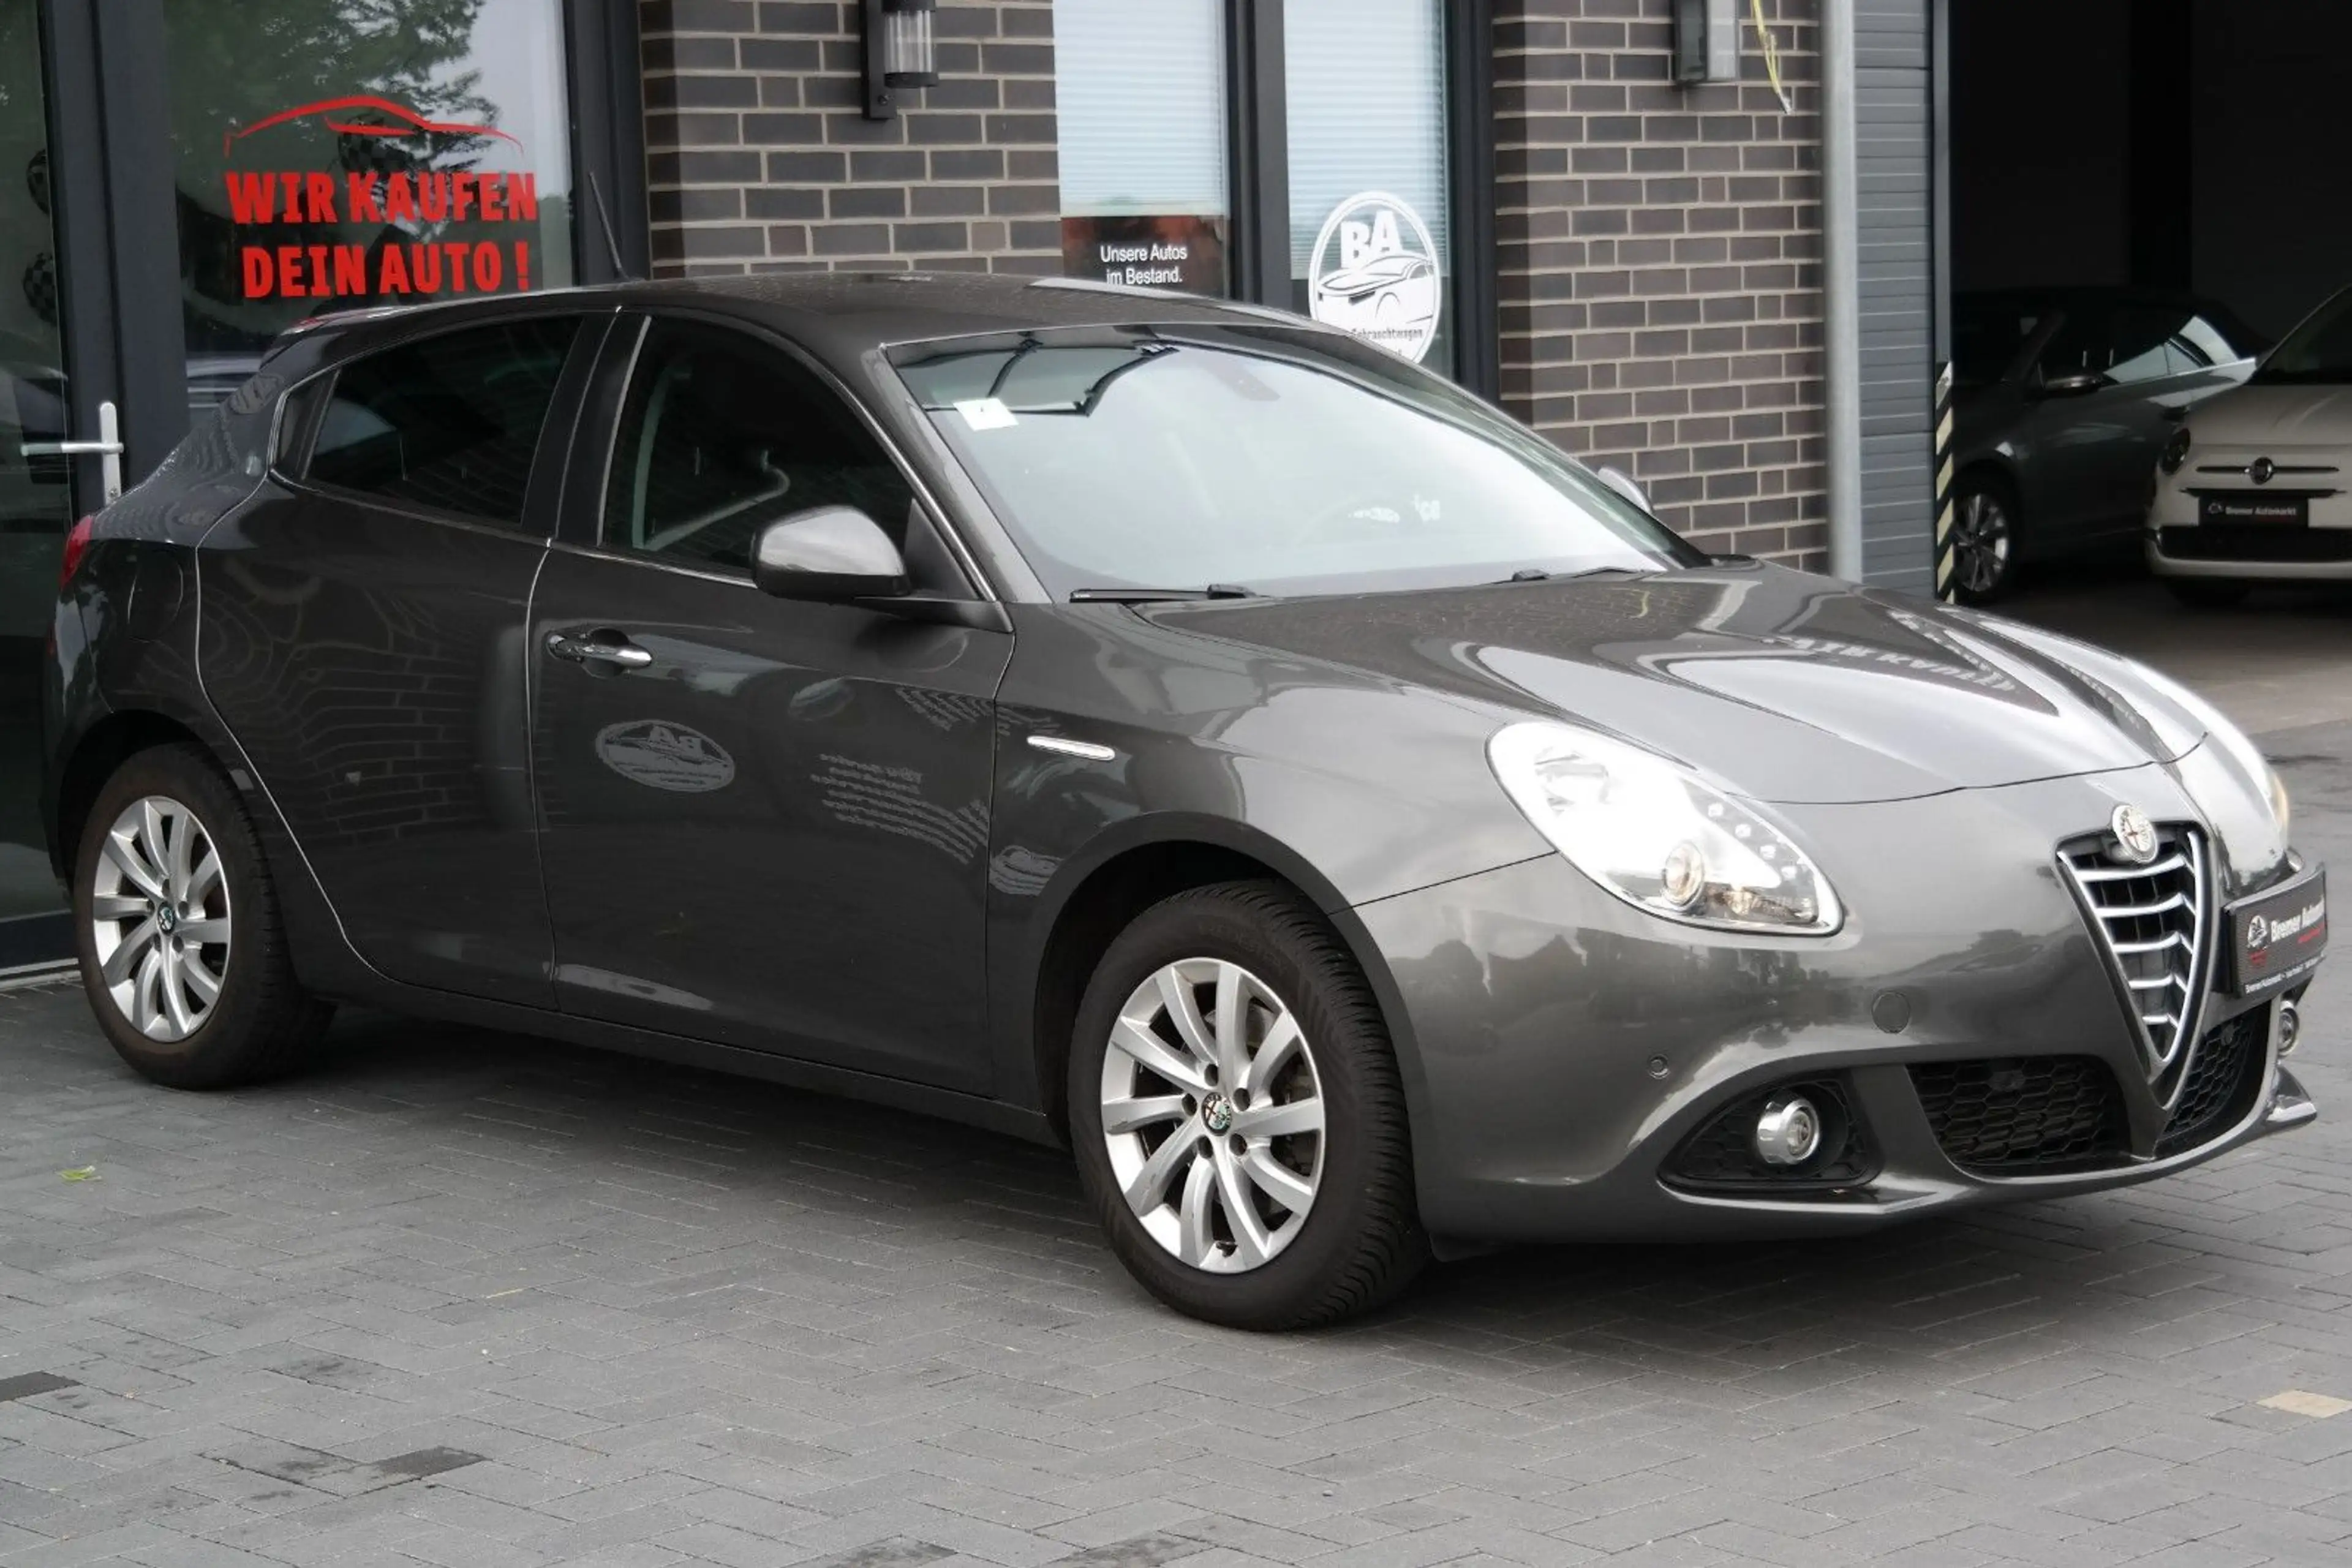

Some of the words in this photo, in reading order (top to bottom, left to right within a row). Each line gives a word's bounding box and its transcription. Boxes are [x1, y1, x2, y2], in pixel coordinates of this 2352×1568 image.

[225, 171, 338, 225] WIR
[347, 171, 537, 224] KAUFEN
[1100, 244, 1148, 263] Unsere
[1150, 243, 1188, 261] Autos
[1340, 209, 1403, 268] BA
[242, 244, 367, 298] DEIN
[379, 242, 502, 295] AUTO
[1106, 268, 1123, 285] im
[1125, 266, 1183, 285] Bestand.
